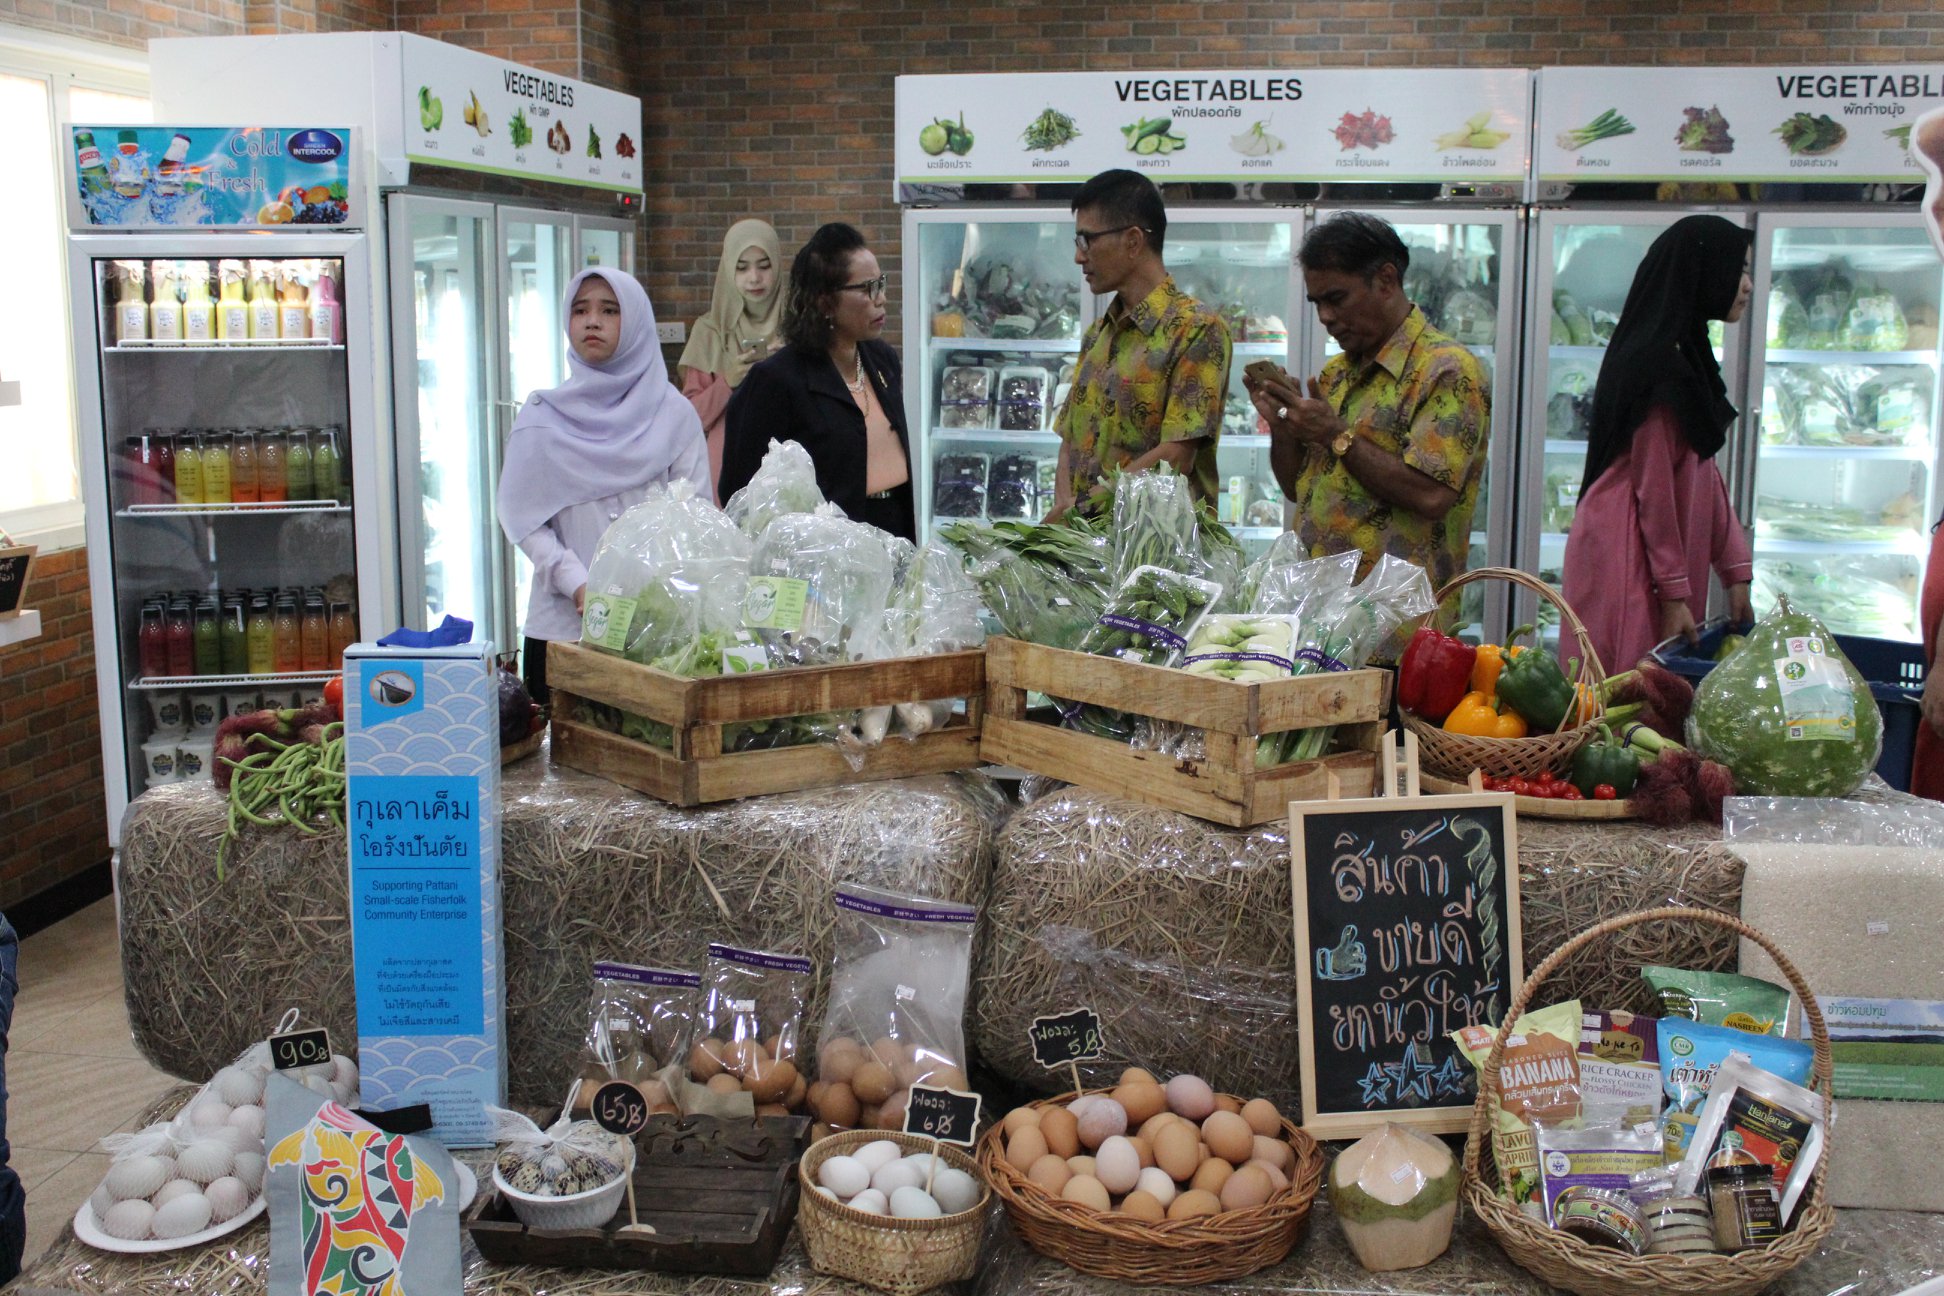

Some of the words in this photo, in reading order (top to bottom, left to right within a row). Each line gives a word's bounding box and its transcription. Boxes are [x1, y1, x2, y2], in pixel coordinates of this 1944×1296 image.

[503, 69, 574, 107] VEGETABLES
[1114, 79, 1303, 102] VEGETABLES
[1777, 75, 1944, 98] VEGETABL
[1172, 106, 1242, 118] ผักปลอดภัย
[230, 130, 282, 157] Cold
[293, 148, 337, 156] INTERCOOL
[225, 158, 237, 169] &
[927, 158, 972, 169] มะเขือเปราะ
[1032, 157, 1070, 168] ผักกะเฉด
[1136, 159, 1170, 168] แตงกวา
[1241, 158, 1273, 168] ดอกแค
[1576, 155, 1611, 167] ต้นหอม
[207, 168, 267, 192] Fresh
[356, 790, 470, 830] กุเลาเค็ม
[359, 833, 468, 858] โอรังปันตัย
[1330, 815, 1448, 903] สินค้า
[372, 880, 423, 892] Supporting
[425, 880, 458, 890] Pattani
[364, 894, 420, 905] Small-scale
[421, 894, 467, 905] Fisherfolk
[845, 900, 881, 913] VEGETABLES
[364, 909, 418, 921] Community
[420, 909, 467, 921] Enterprise
[1372, 881, 1477, 972] ขายดี
[603, 969, 640, 980] VEGETABLES
[1329, 969, 1500, 1053] ยกนิ้วให้
[1828, 1003, 1888, 1019] ข้าวหอมปทุม
[1501, 1057, 1575, 1089] BANANA
[1581, 1063, 1604, 1075] RICE
[1606, 1067, 1654, 1081] CRACKER
[1590, 1076, 1616, 1085] FLOSSY
[1617, 1080, 1652, 1090] CHICKEN
